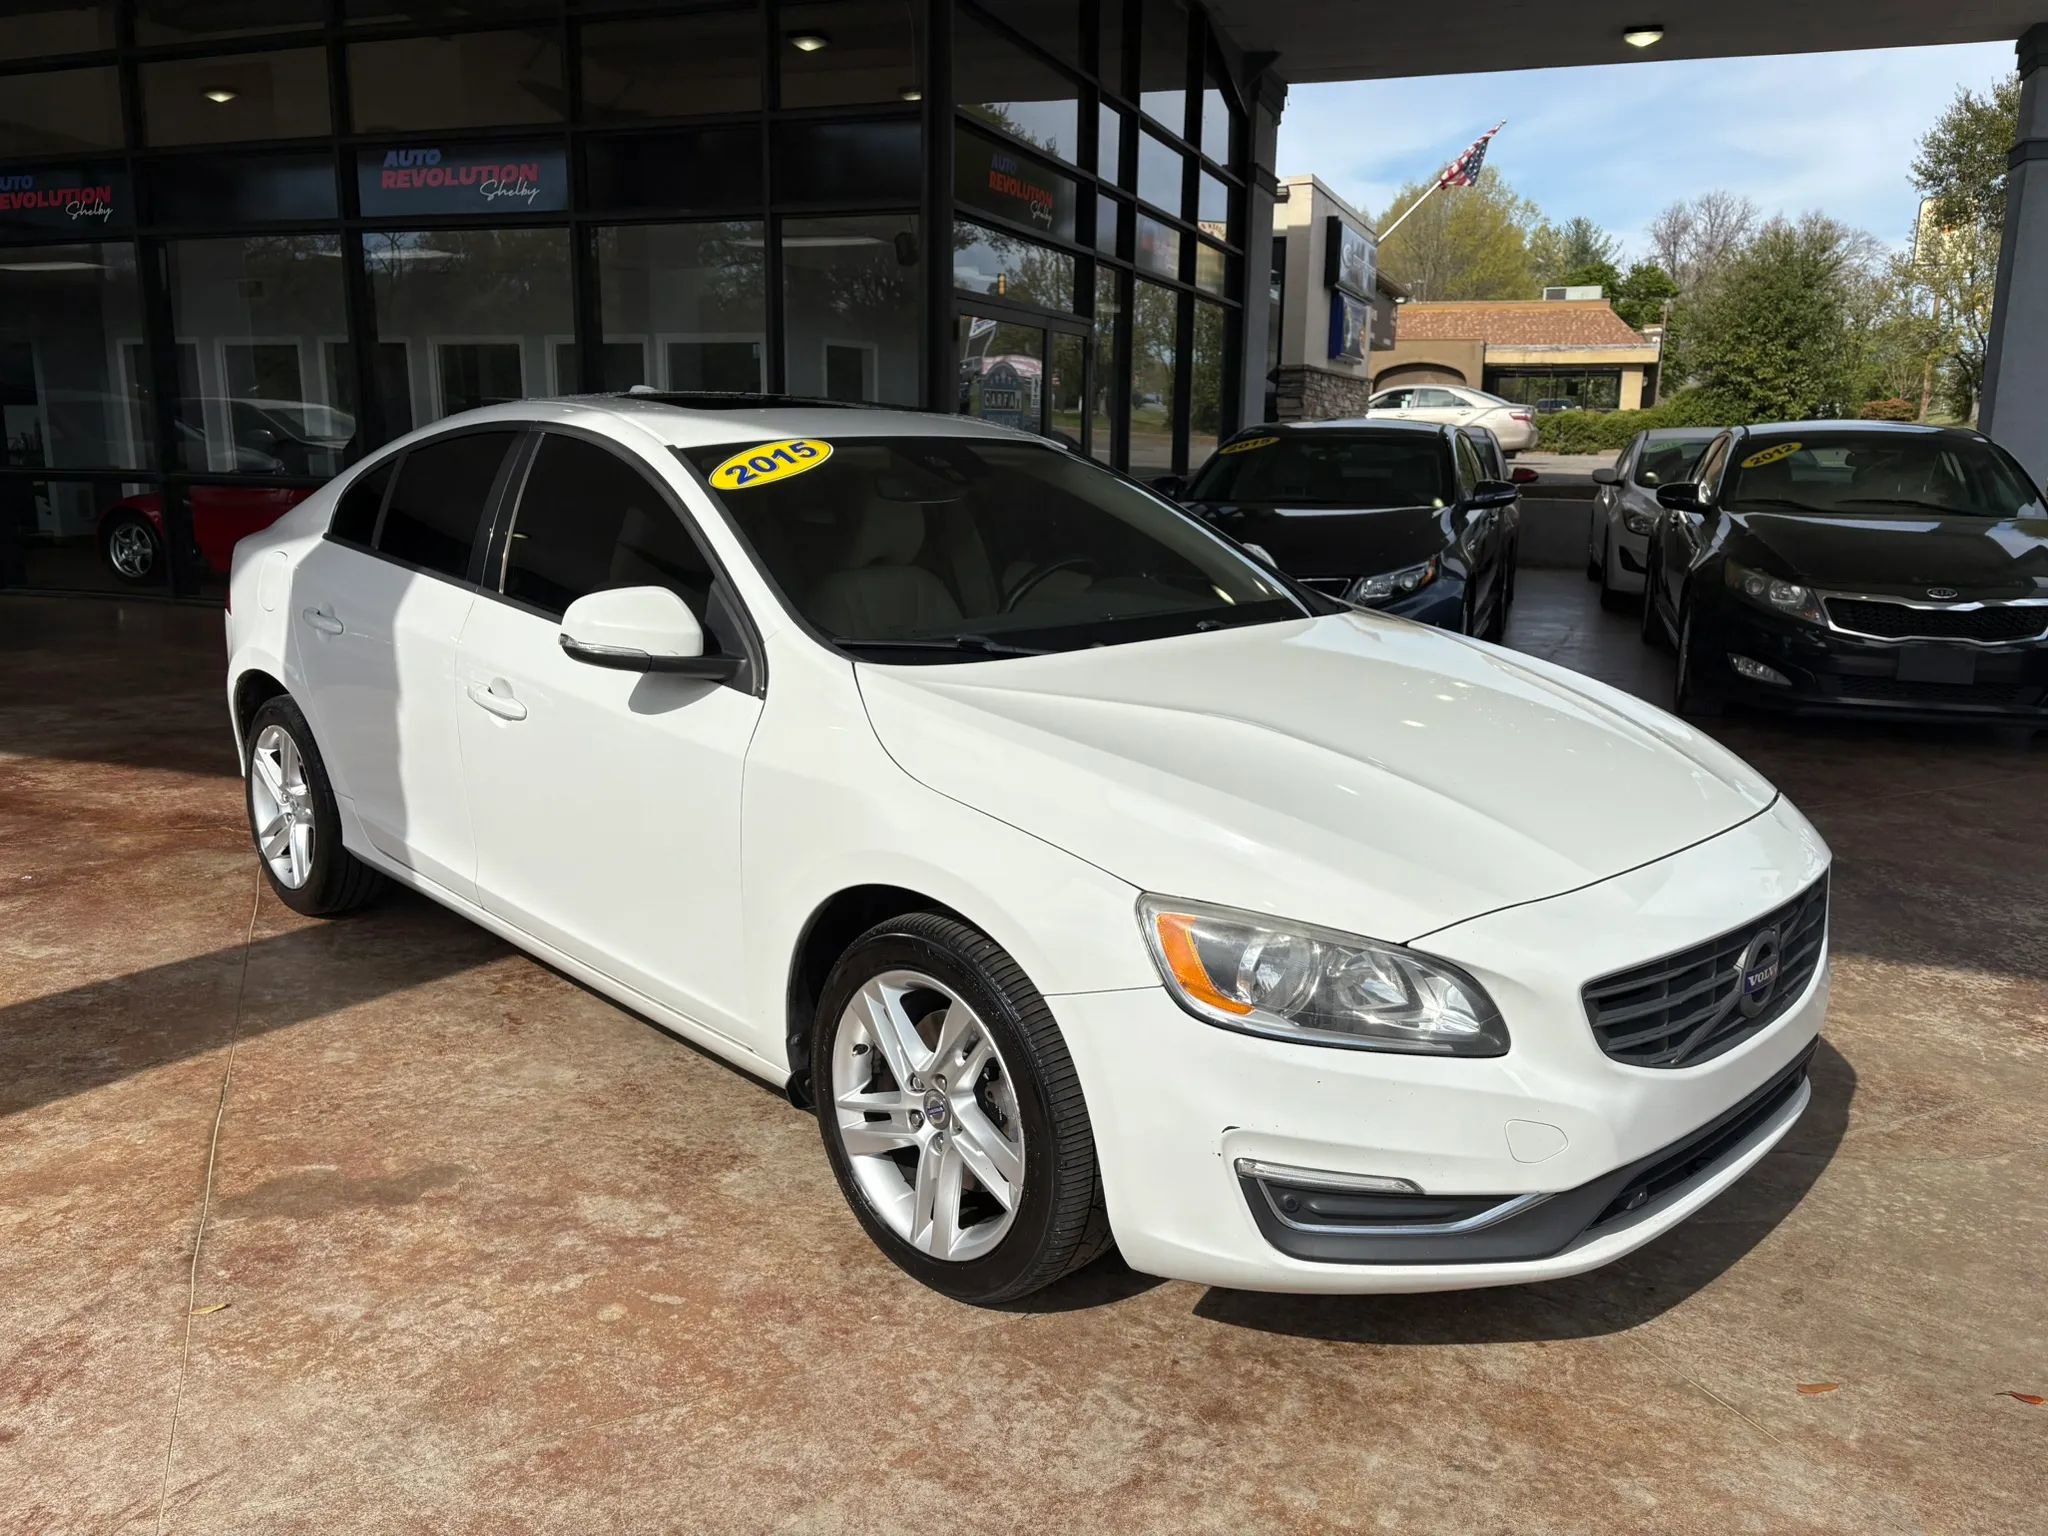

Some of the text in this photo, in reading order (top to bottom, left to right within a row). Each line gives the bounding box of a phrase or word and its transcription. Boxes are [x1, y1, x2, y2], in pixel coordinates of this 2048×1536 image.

[383, 148, 442, 168] AUTO
[0, 175, 33, 191] UTO
[381, 163, 540, 189] REVOLUTION
[988, 170, 1053, 208] REVOLUTION
[0, 184, 112, 210] EVOLUTION
[479, 176, 541, 205] Shelby
[65, 197, 114, 223] Shelby
[725, 441, 818, 485] 2015
